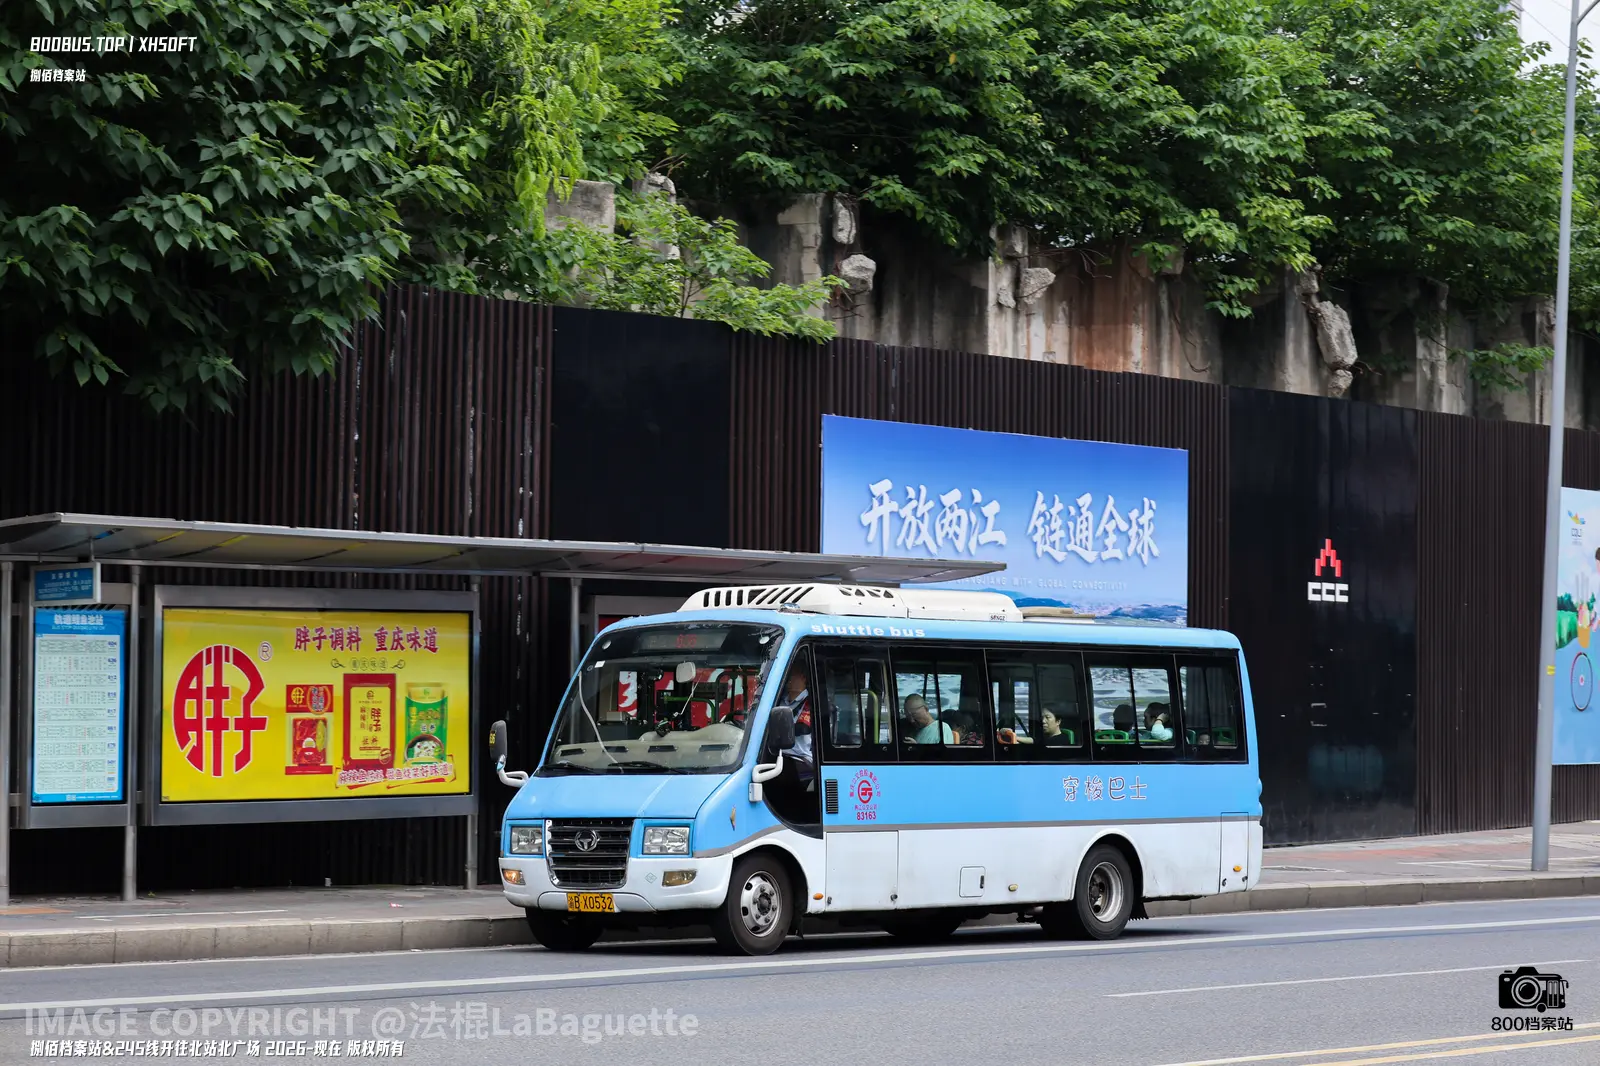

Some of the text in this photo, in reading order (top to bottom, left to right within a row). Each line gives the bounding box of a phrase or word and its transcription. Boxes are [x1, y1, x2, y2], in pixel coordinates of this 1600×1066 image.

[860, 479, 1160, 566] 开放两江 链通全球
[294, 626, 439, 653] 胖子调料 重庆味道
[811, 623, 925, 637] shuttle bus
[1063, 775, 1148, 801] 穿梭巴士
[856, 811, 877, 821] 83163
